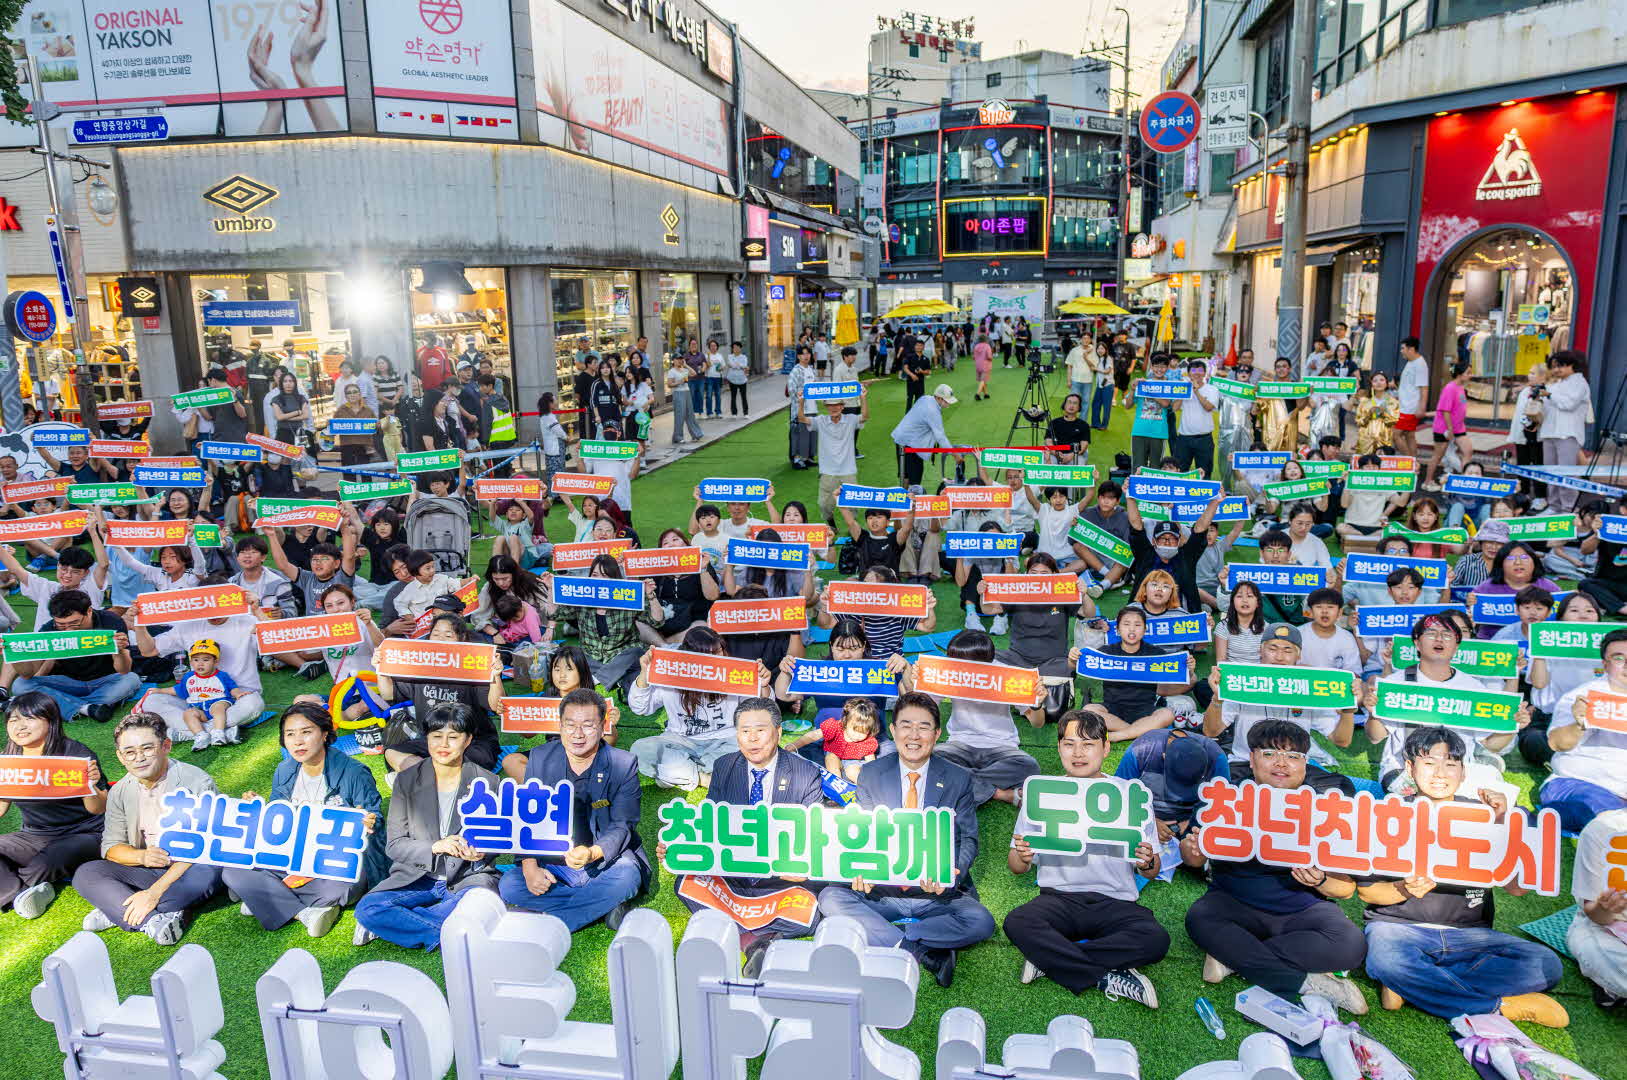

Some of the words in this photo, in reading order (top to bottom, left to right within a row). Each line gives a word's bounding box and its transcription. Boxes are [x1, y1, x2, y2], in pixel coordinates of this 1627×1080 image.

[94, 8, 183, 30] ORIGINAL
[96, 29, 173, 50] YAKSON
[664, 0, 706, 62] 에스테틱
[144, 56, 171, 65] 섬세하고
[172, 54, 192, 64] 다양한
[404, 37, 481, 66] 약손명가
[103, 70, 129, 80] 수기관리
[130, 68, 157, 78] 솔루션을
[158, 66, 192, 77] 만나보세요
[402, 68, 429, 78] GLOBAL
[430, 71, 464, 81] AESTHETIC
[465, 73, 489, 83] LEADER
[1210, 88, 1246, 104] 견인지역
[604, 96, 643, 128] BEAUTY
[93, 119, 147, 132] 연향중앙상가길
[157, 123, 166, 131] 14
[1150, 113, 1193, 129] 주정차금지
[75, 127, 84, 136] 18
[1505, 183, 1542, 200] sportif
[213, 215, 274, 232] umbro
[965, 217, 1028, 235] 아이존팝
[898, 272, 918, 281] PAT
[981, 267, 1010, 277] PAT
[34, 432, 59, 442] 청년의
[206, 445, 231, 455] 청년의
[138, 470, 168, 481] 청년의
[169, 470, 180, 481] 꿈
[181, 471, 202, 481] 실현
[1027, 469, 1053, 480] 청년과
[1053, 470, 1071, 481] 함께
[1072, 471, 1091, 481] 도약
[71, 488, 98, 498] 청년과
[117, 487, 136, 497] 도약
[703, 484, 733, 495] 청년의
[733, 484, 744, 495] 꿈
[745, 485, 765, 496] 실현
[1134, 483, 1171, 496] 청년의
[1173, 485, 1186, 496] 꿈
[1450, 479, 1479, 490] 청년의
[844, 491, 874, 502] 청년의
[874, 491, 885, 502] 꿈
[886, 492, 908, 503] 실현
[931, 501, 948, 511] 순천
[1138, 501, 1163, 513] 청년과
[1222, 502, 1244, 514] 실현
[110, 525, 166, 539] 청년친화도시
[166, 525, 185, 538] 순천
[1547, 519, 1570, 532] 도약
[195, 530, 216, 541] 도약
[806, 531, 825, 542] 순천
[1073, 522, 1098, 543] 청년과
[1098, 535, 1116, 551] 함께
[1114, 542, 1133, 561] 도약
[948, 538, 981, 551] 청년의
[982, 538, 994, 551] 꿈
[995, 538, 1018, 551] 실현
[627, 556, 679, 570] 청년친화도시
[679, 554, 698, 567] 순천
[733, 545, 767, 560] 청년의
[767, 546, 780, 560] 꿈
[780, 548, 803, 562] 실현
[1353, 560, 1394, 577] 청년의
[1235, 570, 1274, 586] 청년의
[1276, 572, 1291, 586] 꿈
[1292, 572, 1319, 587] 실현
[460, 587, 480, 606] 순천
[560, 582, 596, 600] 청년의
[597, 586, 611, 600] 꿈
[611, 586, 636, 602] 실현
[987, 581, 1053, 596] 청년친화도시
[1053, 581, 1077, 595] 순천
[139, 596, 217, 616] 청년친화도시
[217, 591, 243, 608] 순천
[832, 589, 899, 608] 청년친화도시
[899, 593, 924, 608] 순천
[714, 607, 782, 625] 청년친화도시
[782, 604, 806, 622] 순천
[1365, 613, 1409, 629] 청년의
[261, 625, 331, 645] 청년친화도시
[330, 621, 356, 638] 순천
[1156, 621, 1170, 636] 꿈
[1172, 619, 1200, 635] 실현
[8, 639, 50, 654] 청년과
[50, 637, 79, 652] 함께
[80, 635, 109, 650] 도약
[1538, 629, 1589, 649] 청년과
[384, 647, 461, 670] 청년친화도시
[462, 652, 489, 671] 순천
[1085, 654, 1128, 672] 청년의
[1131, 658, 1147, 673] 꿈
[1149, 660, 1180, 674] 실현
[1479, 650, 1513, 669] 도약
[654, 657, 727, 683] 청년친화도시
[728, 667, 755, 686] 순천
[796, 664, 844, 684] 청년의
[846, 666, 864, 684] 꿈
[866, 668, 896, 686] 실현
[922, 666, 1003, 692] 청년친화도시
[1004, 675, 1034, 697] 순천
[1226, 673, 1275, 694] 청년과
[1275, 677, 1311, 697] 함께
[1312, 680, 1347, 699] 도약
[1384, 691, 1435, 714] 청년과
[1436, 696, 1473, 717] 함께
[1473, 701, 1512, 721] 도약
[52, 767, 84, 788] 순천
[460, 777, 571, 853] 실현
[1026, 779, 1148, 861] 도약
[661, 800, 829, 880] 청년과
[835, 806, 952, 885] 함께
[1200, 780, 1559, 894] 청년친화도시
[776, 893, 812, 911] 순천
